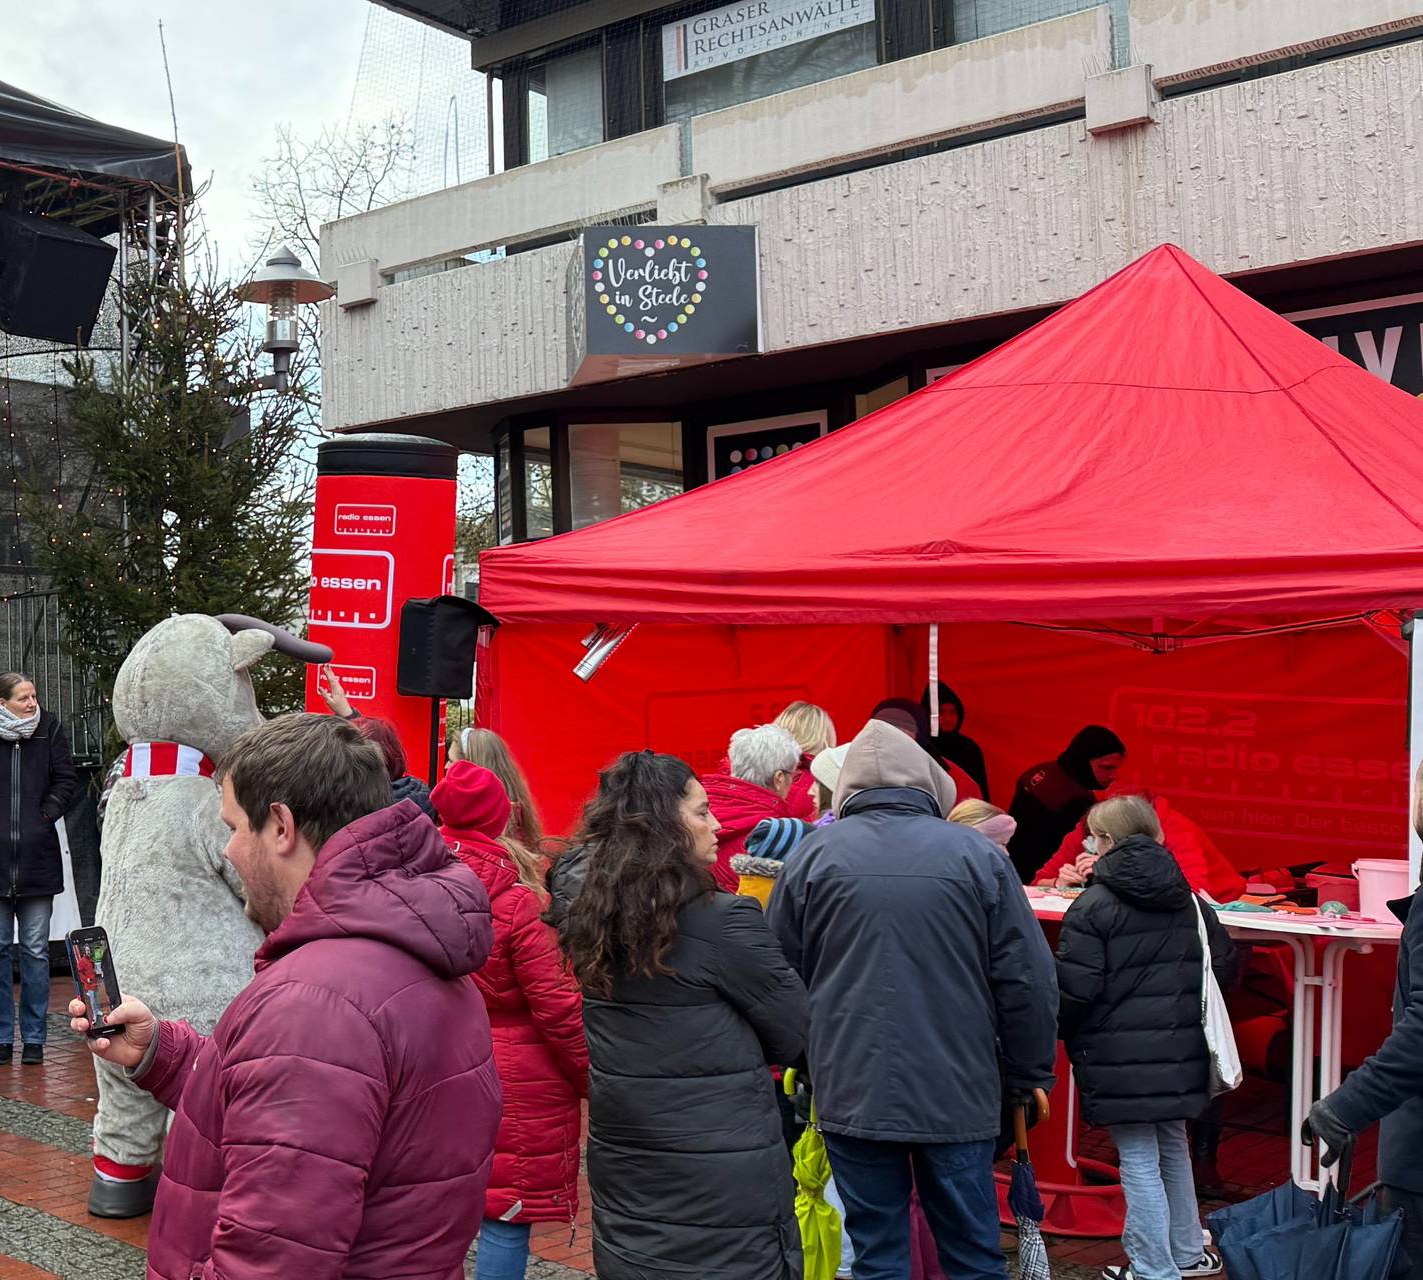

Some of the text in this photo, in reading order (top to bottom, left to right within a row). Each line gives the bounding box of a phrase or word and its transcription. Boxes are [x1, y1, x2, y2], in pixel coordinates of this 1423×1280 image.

[692, 1, 770, 36] GRASER
[694, 0, 861, 56] RECHTSANWÄLTE
[607, 258, 693, 288] Verliebt
[615, 285, 691, 311] in Steele
[338, 513, 360, 521] radio
[320, 576, 382, 591] essen
[342, 675, 371, 684] essen
[1132, 703, 1257, 737] 102.2
[1152, 743, 1409, 782] radio esse
[1294, 812, 1334, 831] Der
